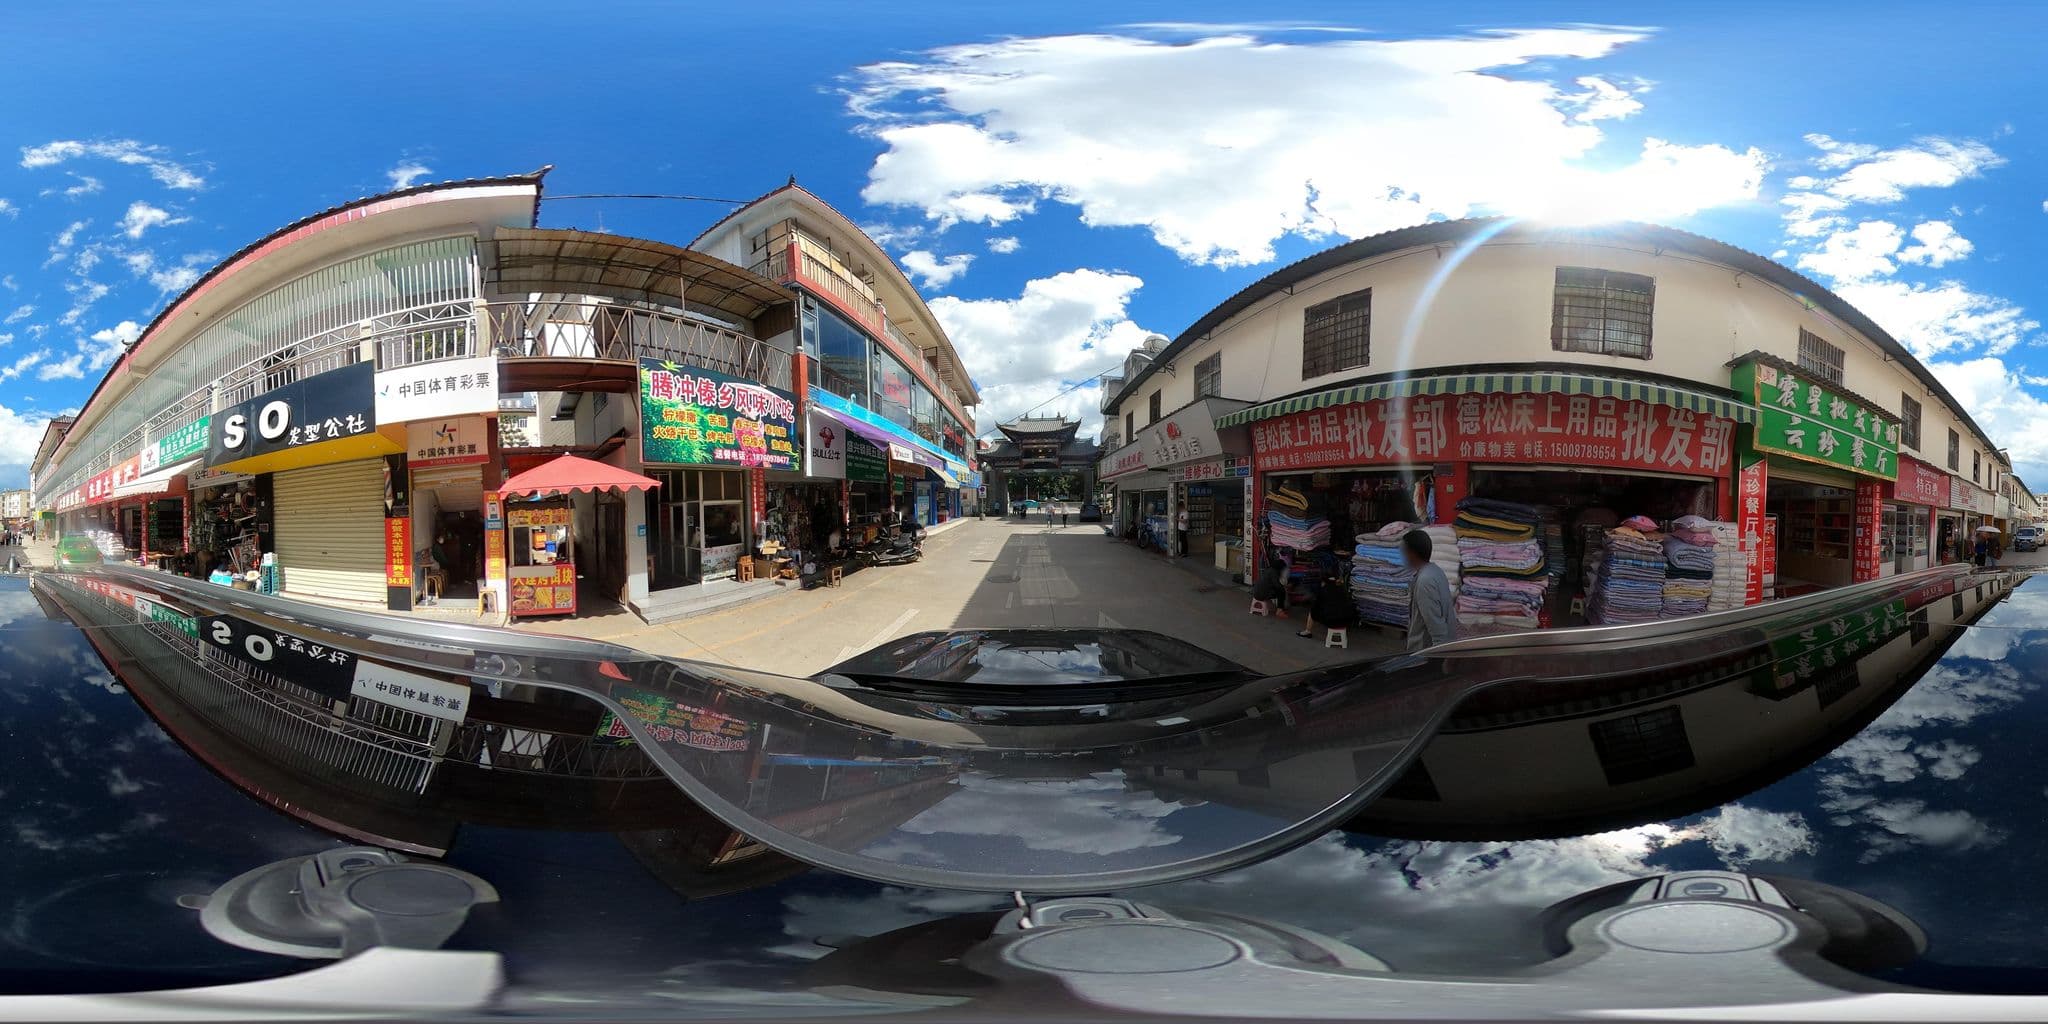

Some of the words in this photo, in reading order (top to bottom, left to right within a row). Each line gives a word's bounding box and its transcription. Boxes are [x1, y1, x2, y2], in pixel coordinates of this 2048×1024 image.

[399, 372, 490, 398] 中国体育彩票
[650, 371, 795, 422] 腾冲傣乡风味小吃
[288, 413, 368, 446] 发型公社
[653, 425, 698, 441] 火烧干巴
[1254, 411, 1342, 453] 德松床上用品
[1344, 397, 1448, 458] 批发部
[1456, 395, 1617, 439] 德松床上用品
[1621, 403, 1733, 473] 批发部
[417, 444, 477, 459] 中国体育彩票
[812, 447, 841, 460] BULL公牛
[1460, 440, 1516, 459] 价廉物美
